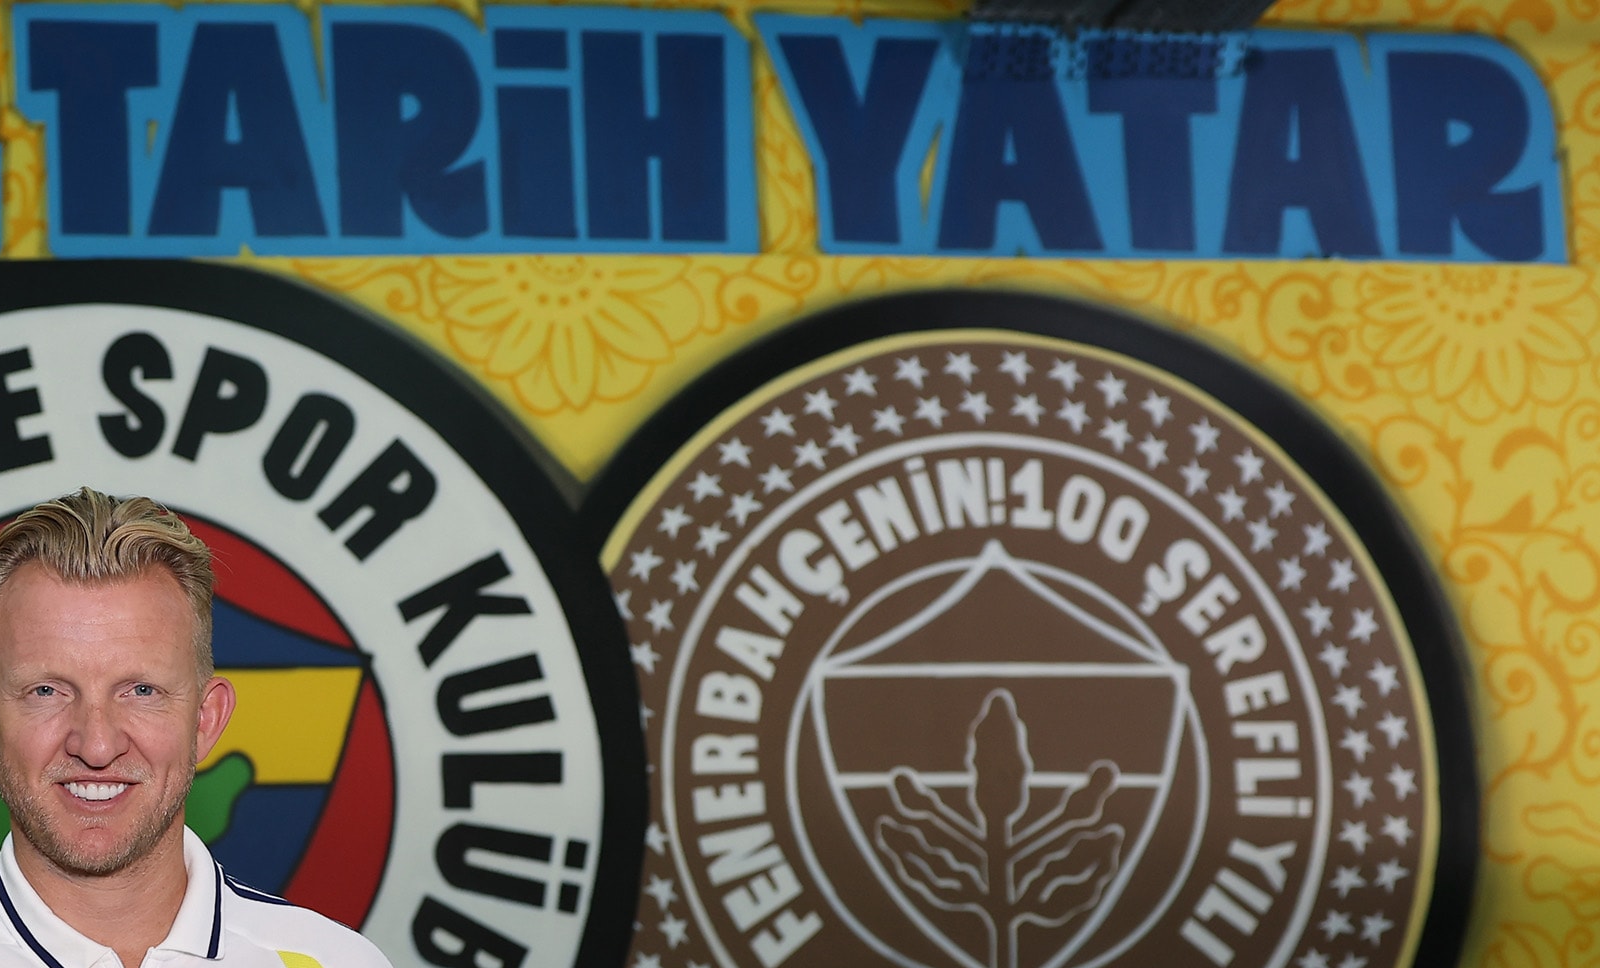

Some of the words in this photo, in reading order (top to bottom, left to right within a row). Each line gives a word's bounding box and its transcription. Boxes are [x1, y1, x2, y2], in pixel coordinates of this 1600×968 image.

[776, 33, 1545, 263] YATAR
[96, 330, 437, 562] SPOR
[1180, 837, 1298, 968] YILI
